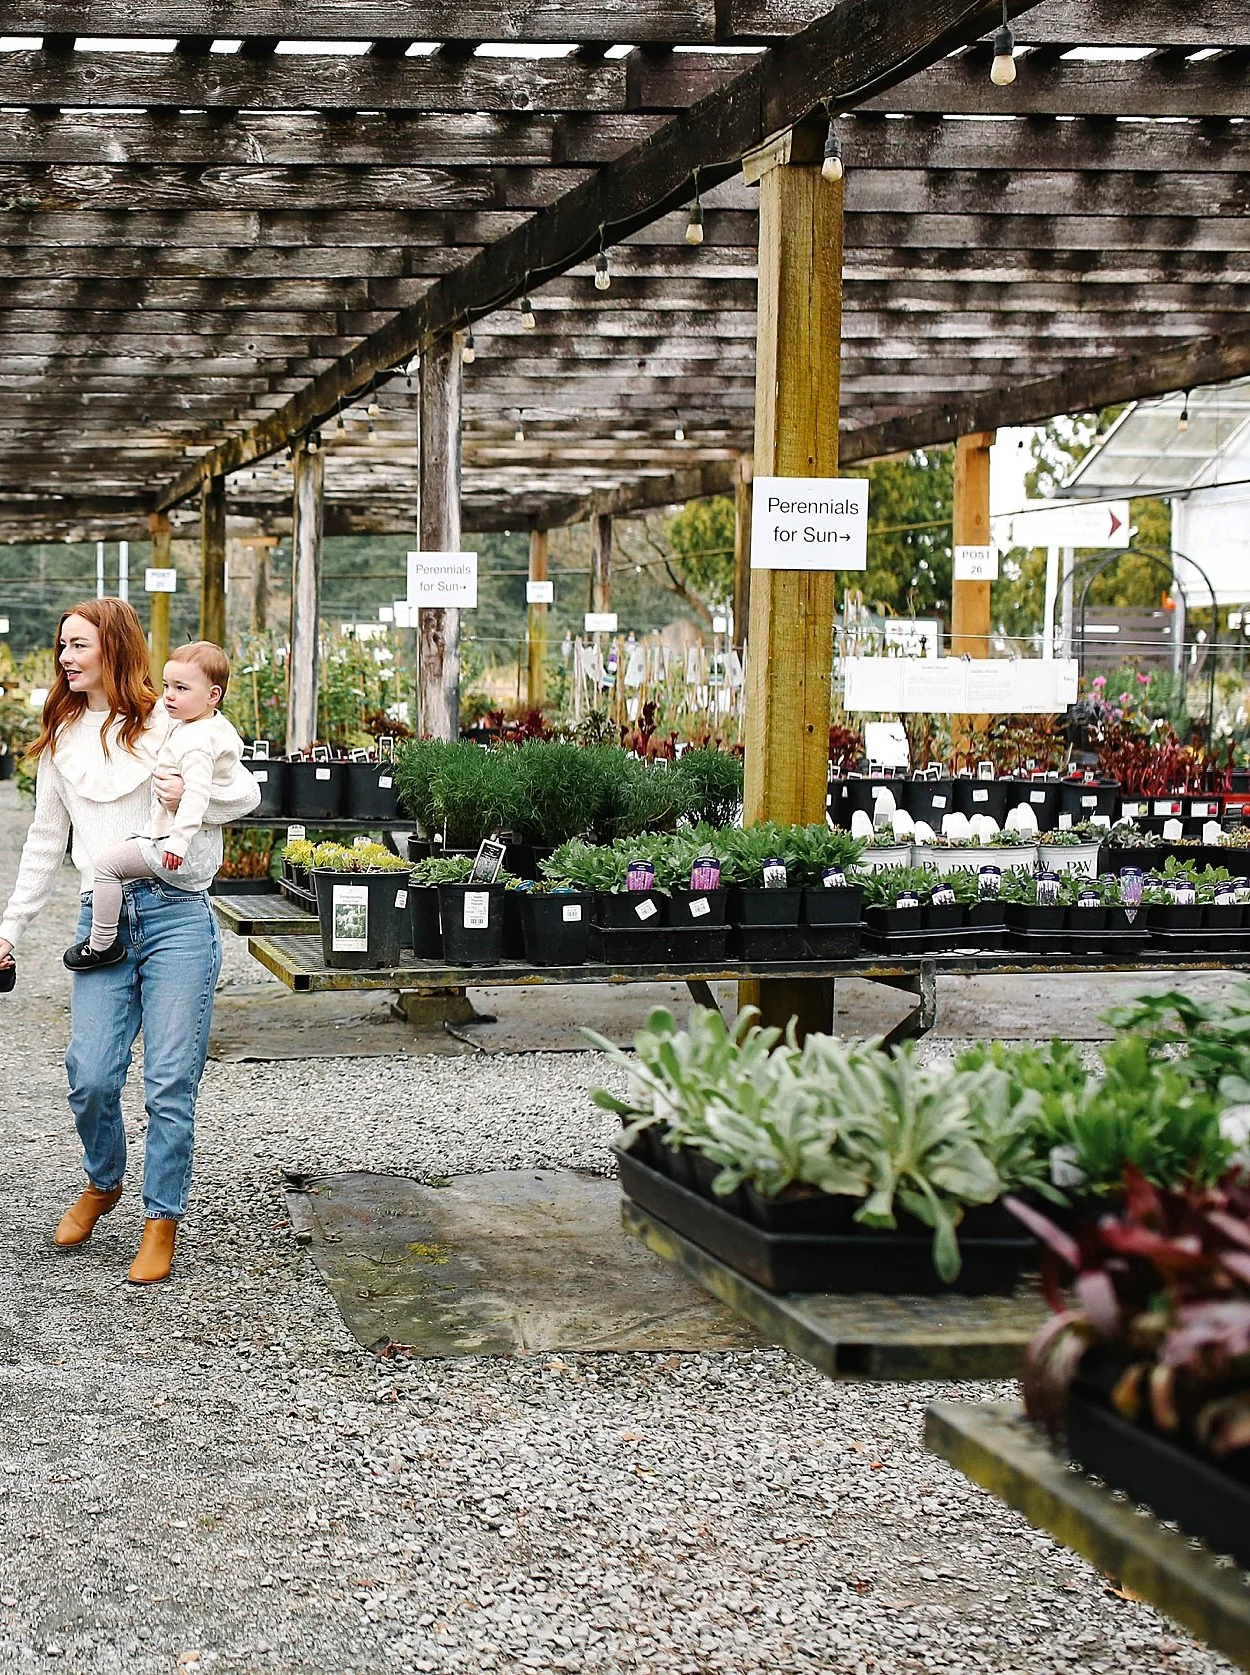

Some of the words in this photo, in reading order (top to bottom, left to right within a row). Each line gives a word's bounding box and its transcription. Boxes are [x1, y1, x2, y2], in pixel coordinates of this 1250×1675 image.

[768, 497, 859, 515] Perennials
[773, 526, 798, 542] for
[803, 526, 838, 543] Sun
[416, 563, 471, 575] Perennials
[420, 580, 434, 592] for
[437, 580, 459, 592] Sun
